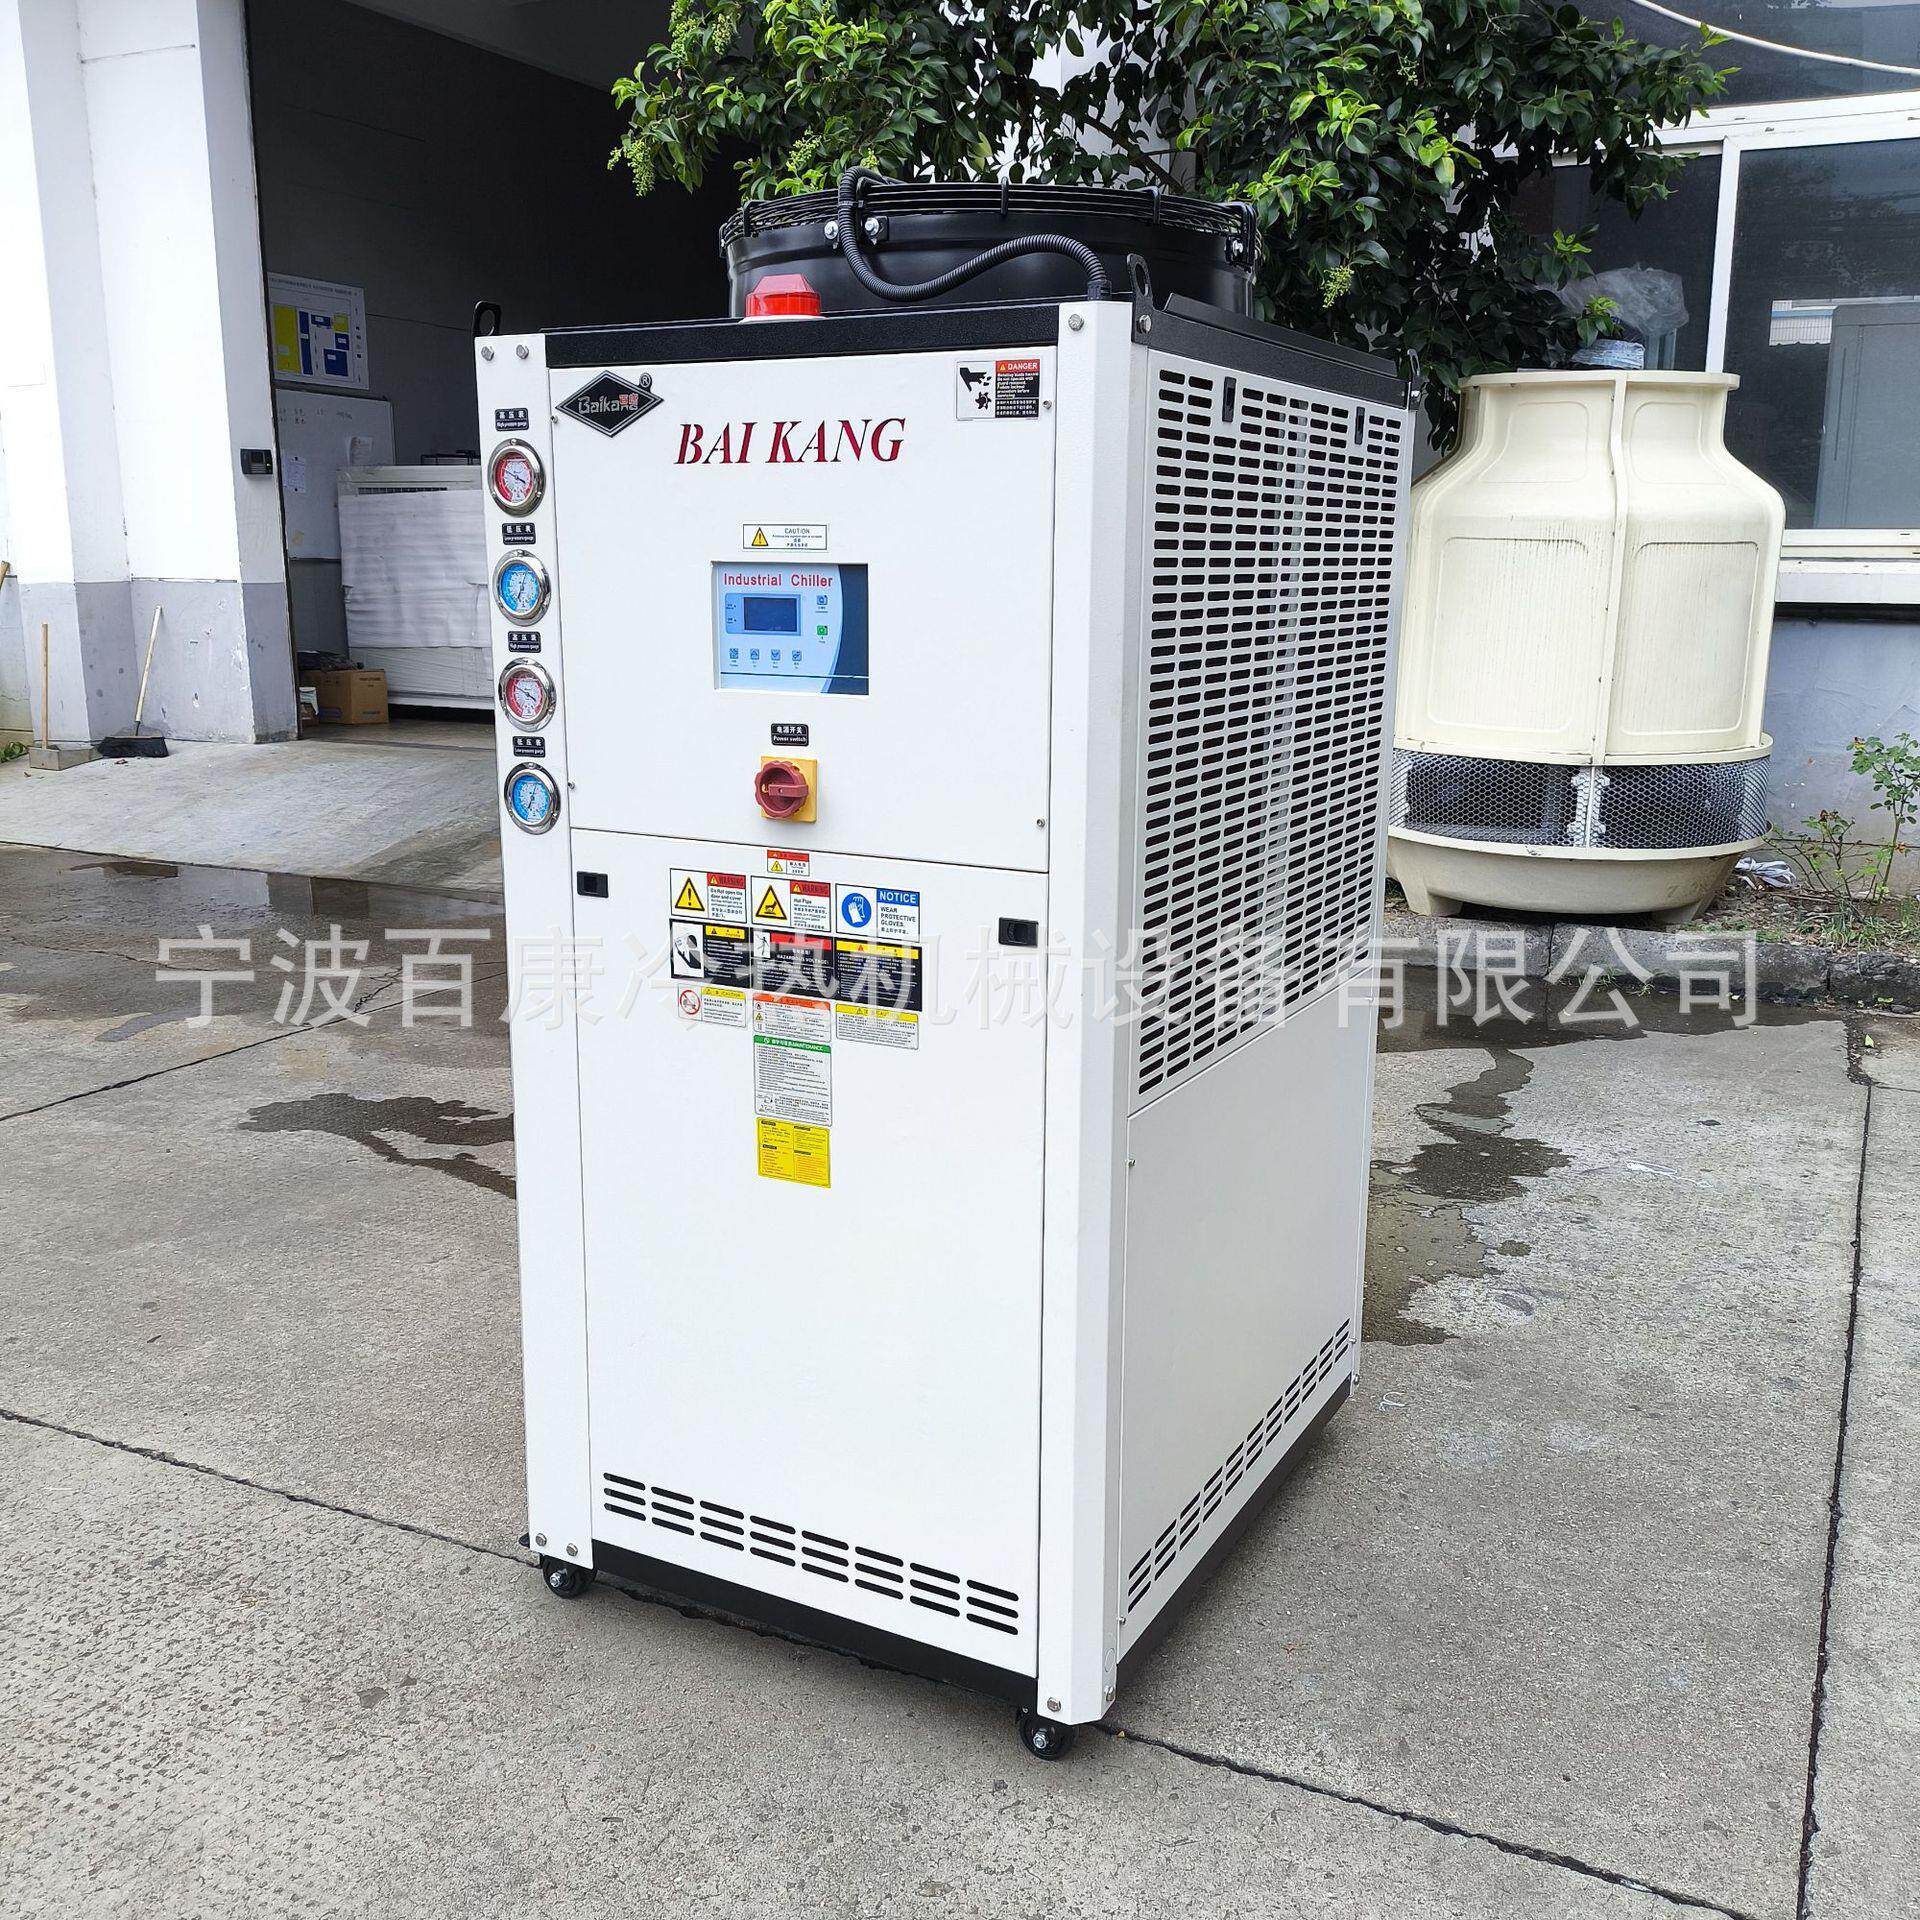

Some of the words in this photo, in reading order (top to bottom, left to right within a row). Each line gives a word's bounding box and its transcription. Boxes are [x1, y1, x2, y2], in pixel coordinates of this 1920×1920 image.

[1007, 362, 1038, 371] DANGER
[674, 421, 758, 465] BAI
[765, 417, 906, 464] KANG
[724, 573, 782, 586] Industrial
[791, 574, 833, 587] Chiller
[776, 726, 803, 734] 电源开关
[879, 890, 917, 904] NOTICE
[880, 912, 917, 923] PROTECTIVE
